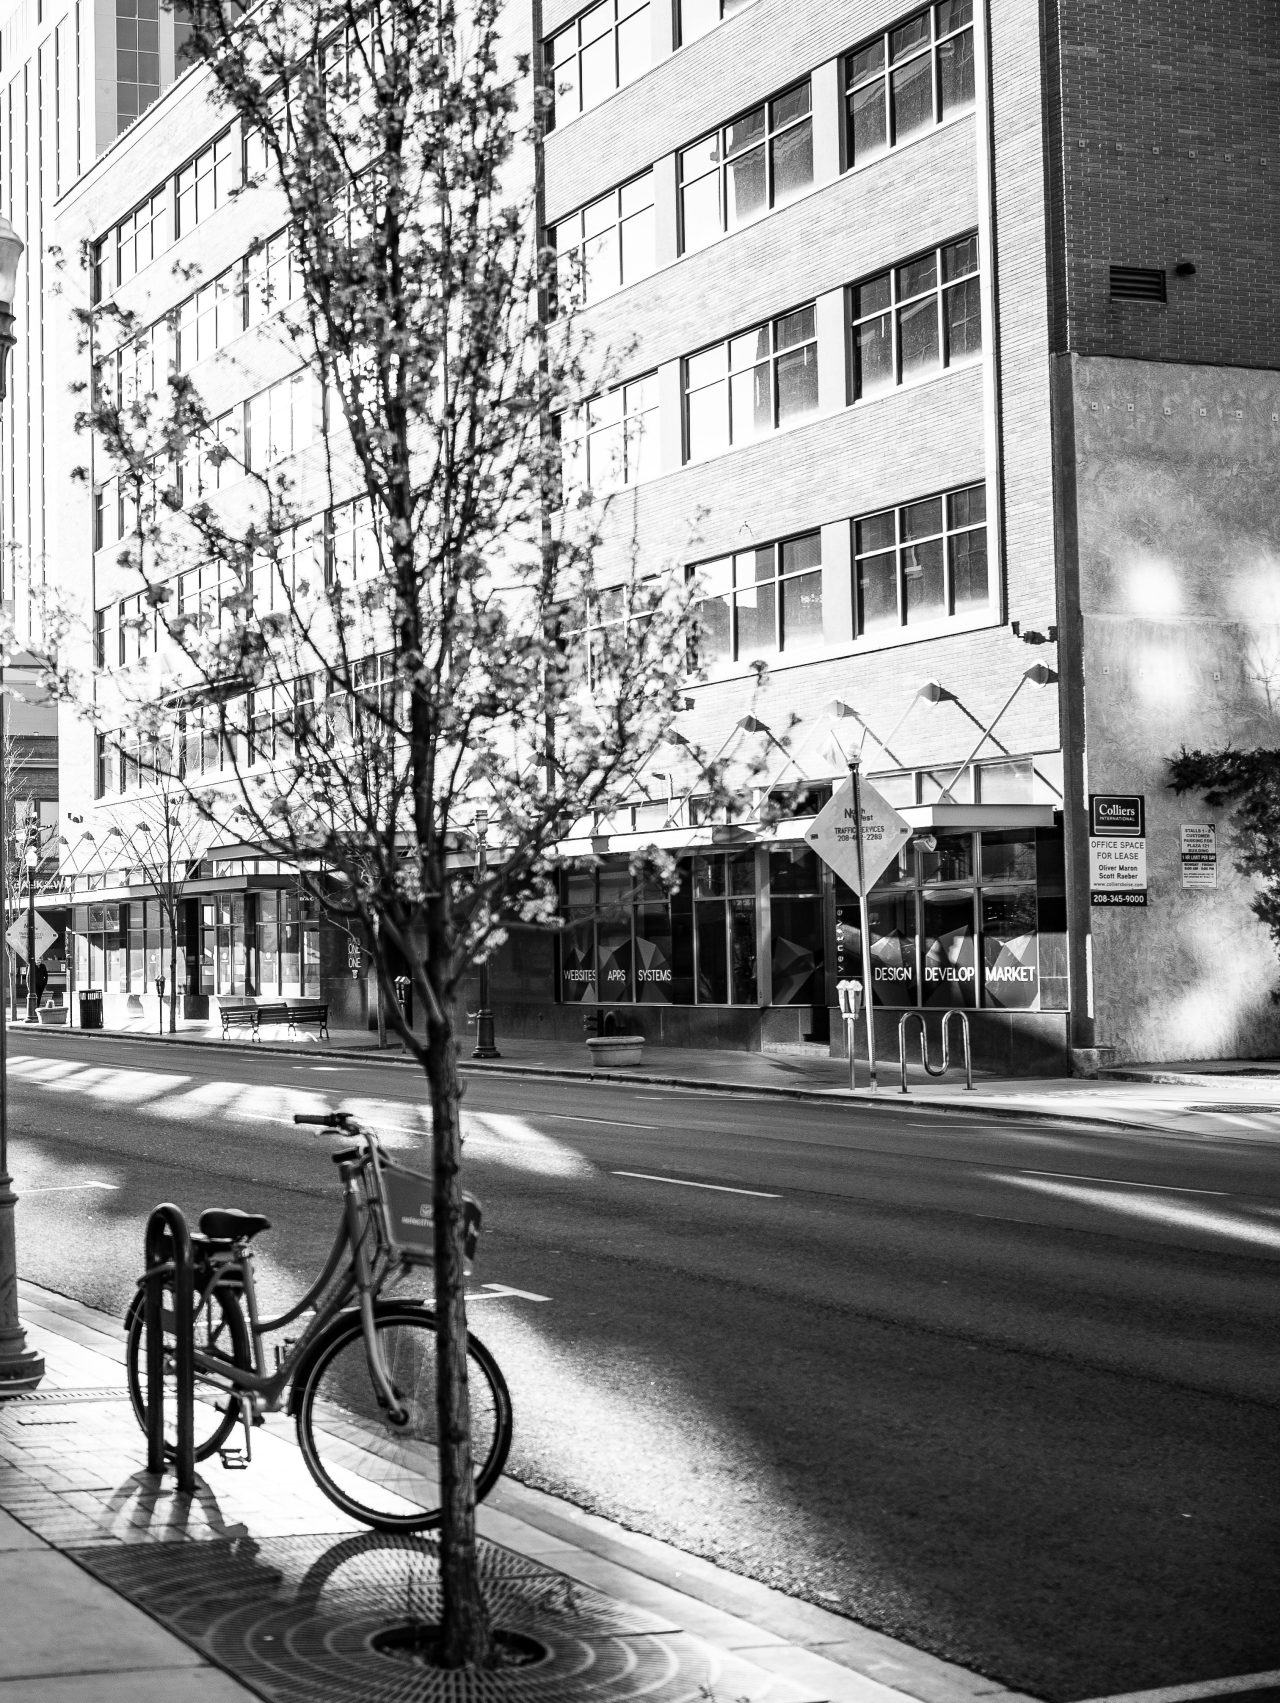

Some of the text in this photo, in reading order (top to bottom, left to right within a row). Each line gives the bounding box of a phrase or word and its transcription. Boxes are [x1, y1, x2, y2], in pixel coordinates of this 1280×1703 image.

[1099, 803, 1135, 816] Colliers
[1091, 841, 1144, 849] OFFICE SPACE
[1114, 852, 1139, 860] LEASE
[1116, 872, 1138, 880] Raeber
[1093, 894, 1145, 903] 208-345-9000
[348, 943, 361, 954] ONE
[348, 957, 362, 968] ONE
[563, 969, 596, 981] WEBSITES
[607, 969, 626, 981] APPS
[638, 969, 672, 982] SYSTEMS
[874, 966, 912, 981] DESIGN
[925, 966, 975, 982] DEVELOP
[985, 966, 1036, 982] MARKET
